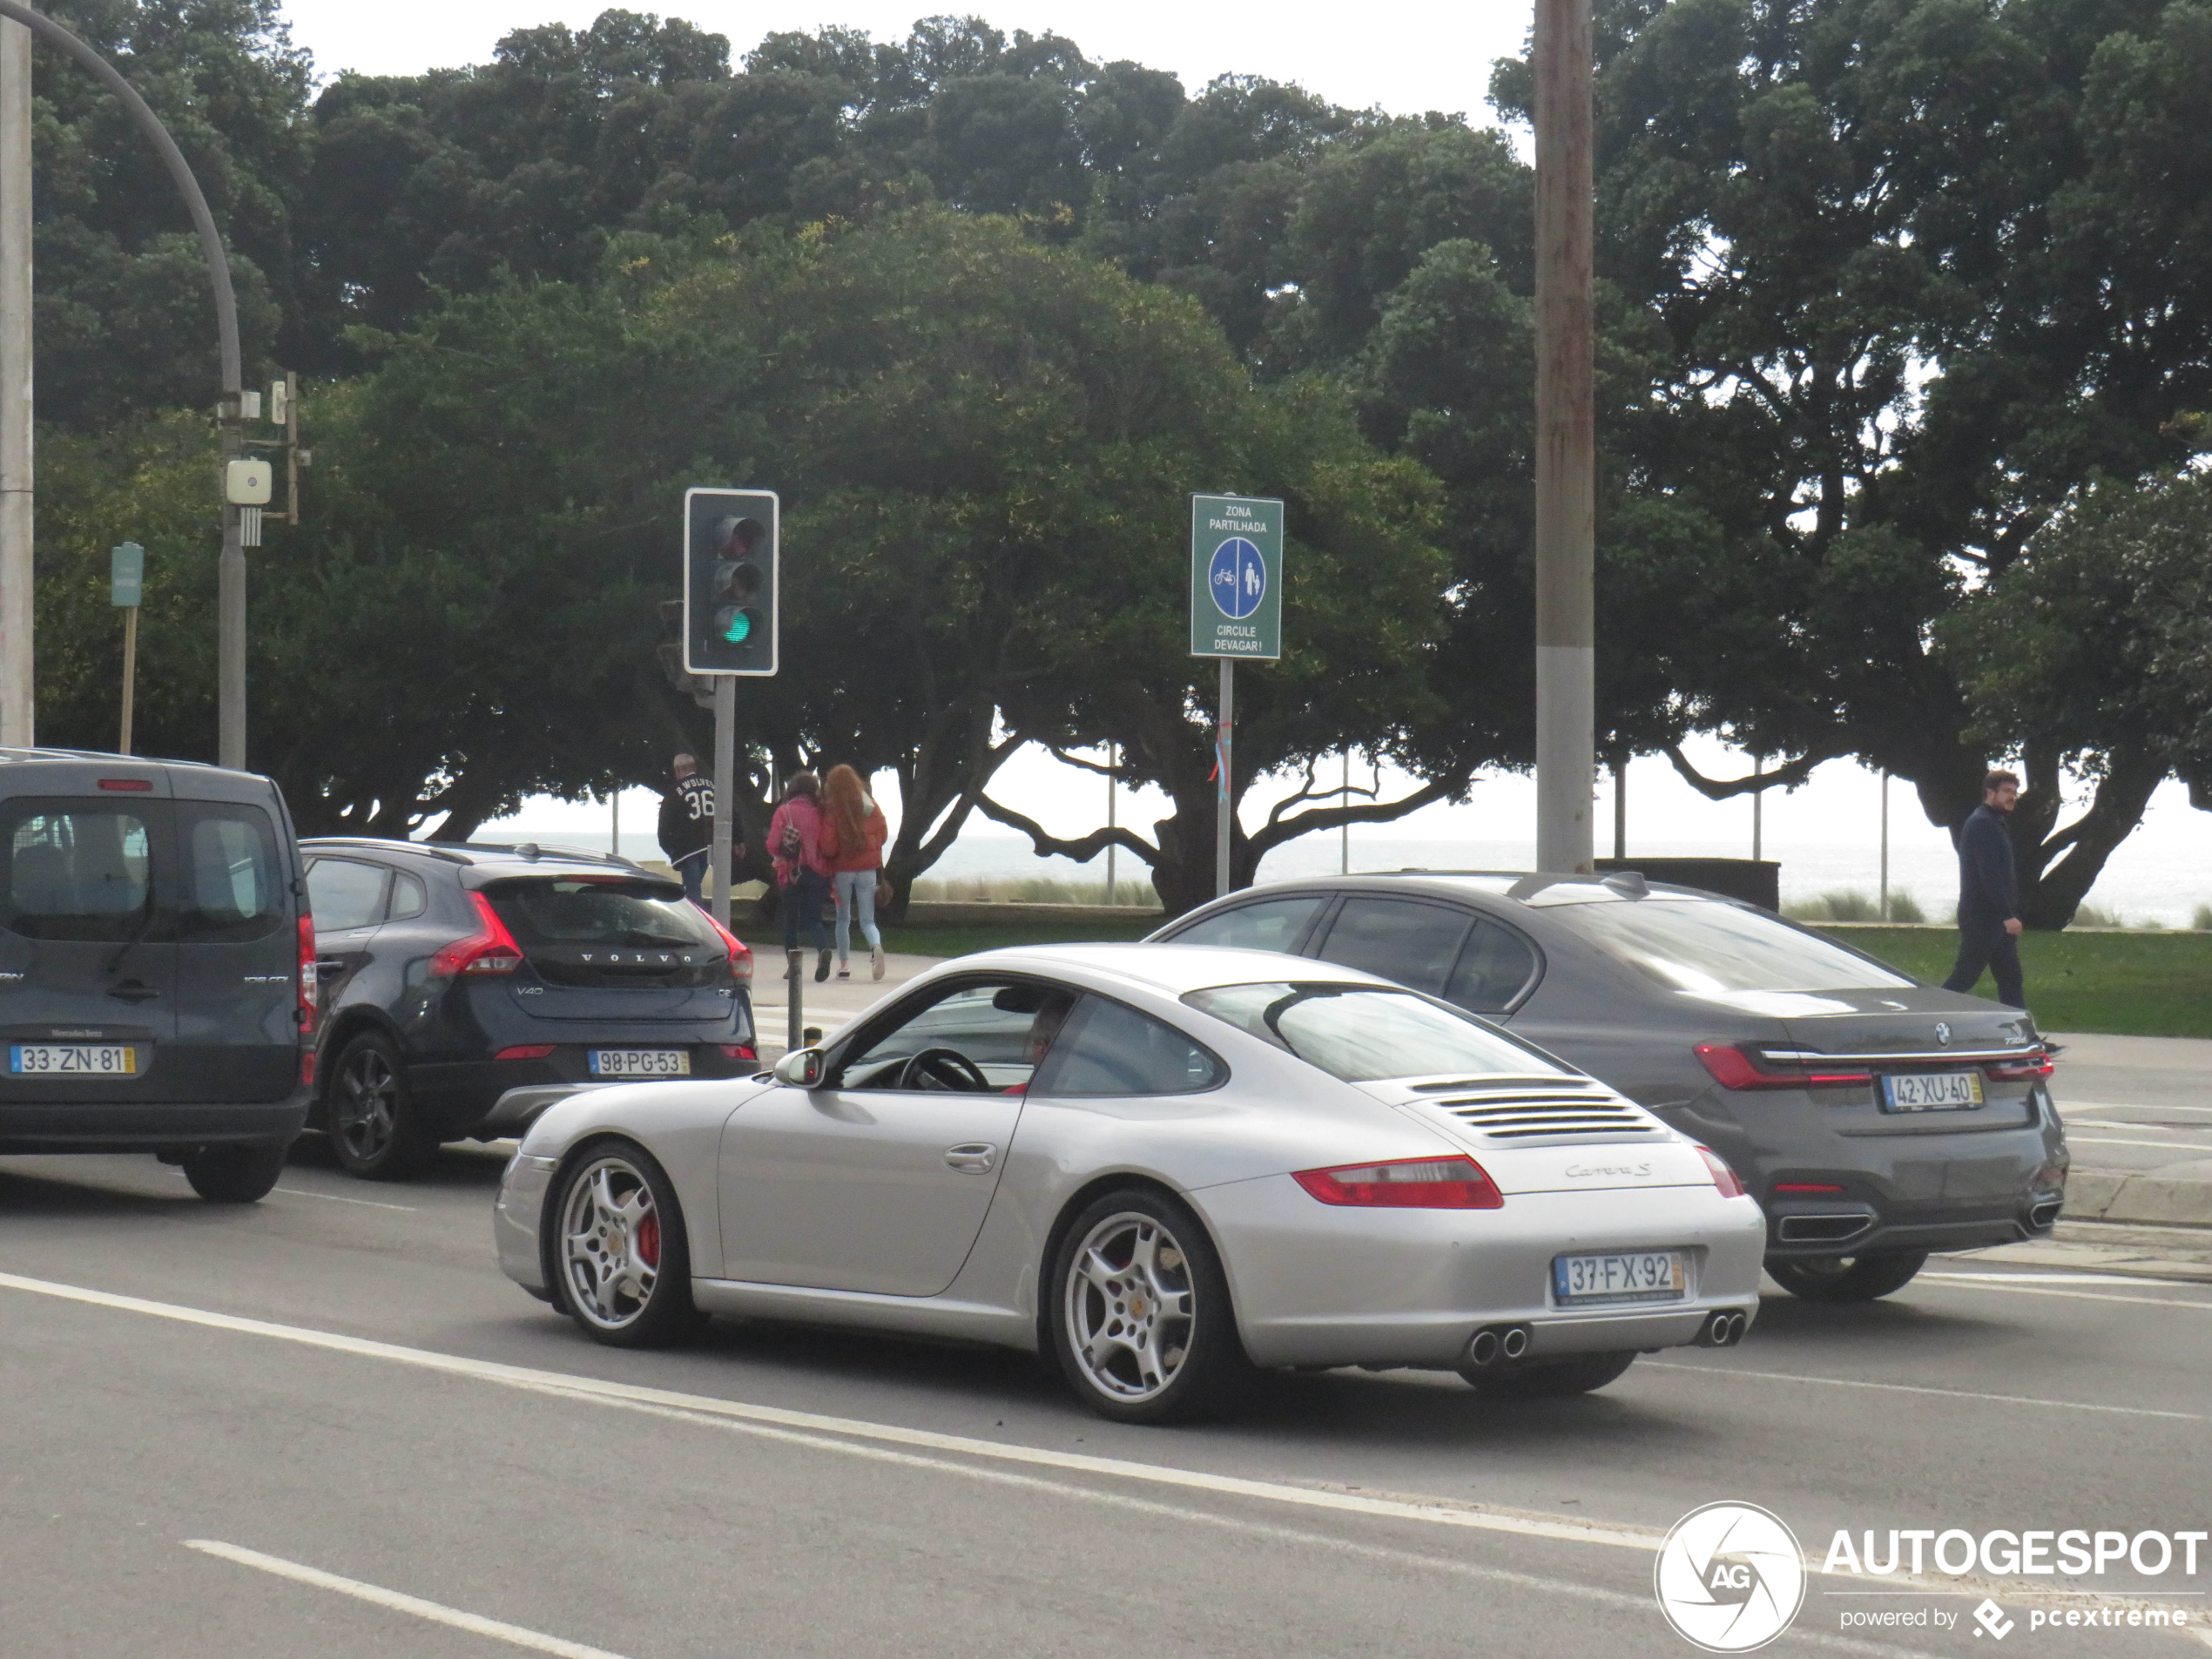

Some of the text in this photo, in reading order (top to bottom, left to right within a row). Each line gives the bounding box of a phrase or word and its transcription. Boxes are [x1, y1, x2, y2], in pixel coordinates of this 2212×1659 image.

[1225, 505, 1251, 517] ZONA
[1209, 518, 1267, 533] PARTILHADA
[1217, 624, 1256, 637] CIRCULE
[685, 790, 714, 819] 36
[582, 954, 691, 962] VOLVO
[1634, 1163, 1651, 1177] S
